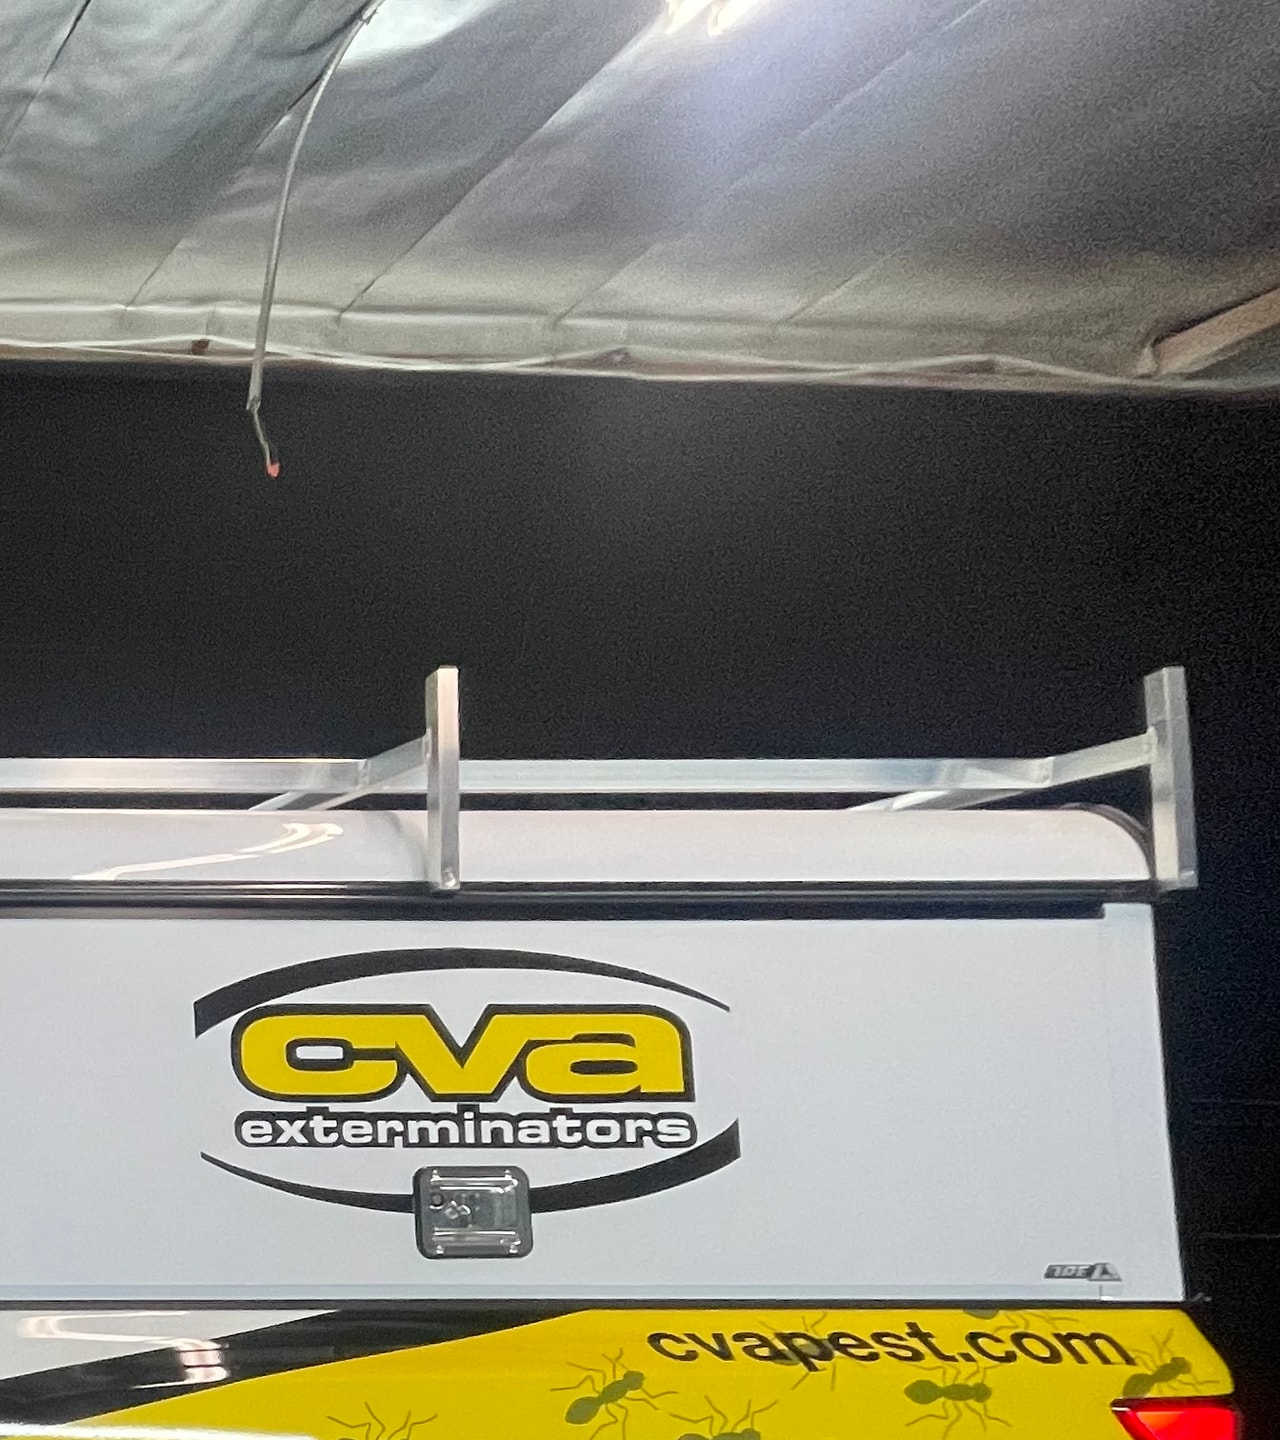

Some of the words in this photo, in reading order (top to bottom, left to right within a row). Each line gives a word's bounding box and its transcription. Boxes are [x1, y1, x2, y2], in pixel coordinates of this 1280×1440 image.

[231, 1003, 695, 1102] cva
[239, 1107, 693, 1147] exterminators
[646, 1321, 1138, 1372] cvapest.com
